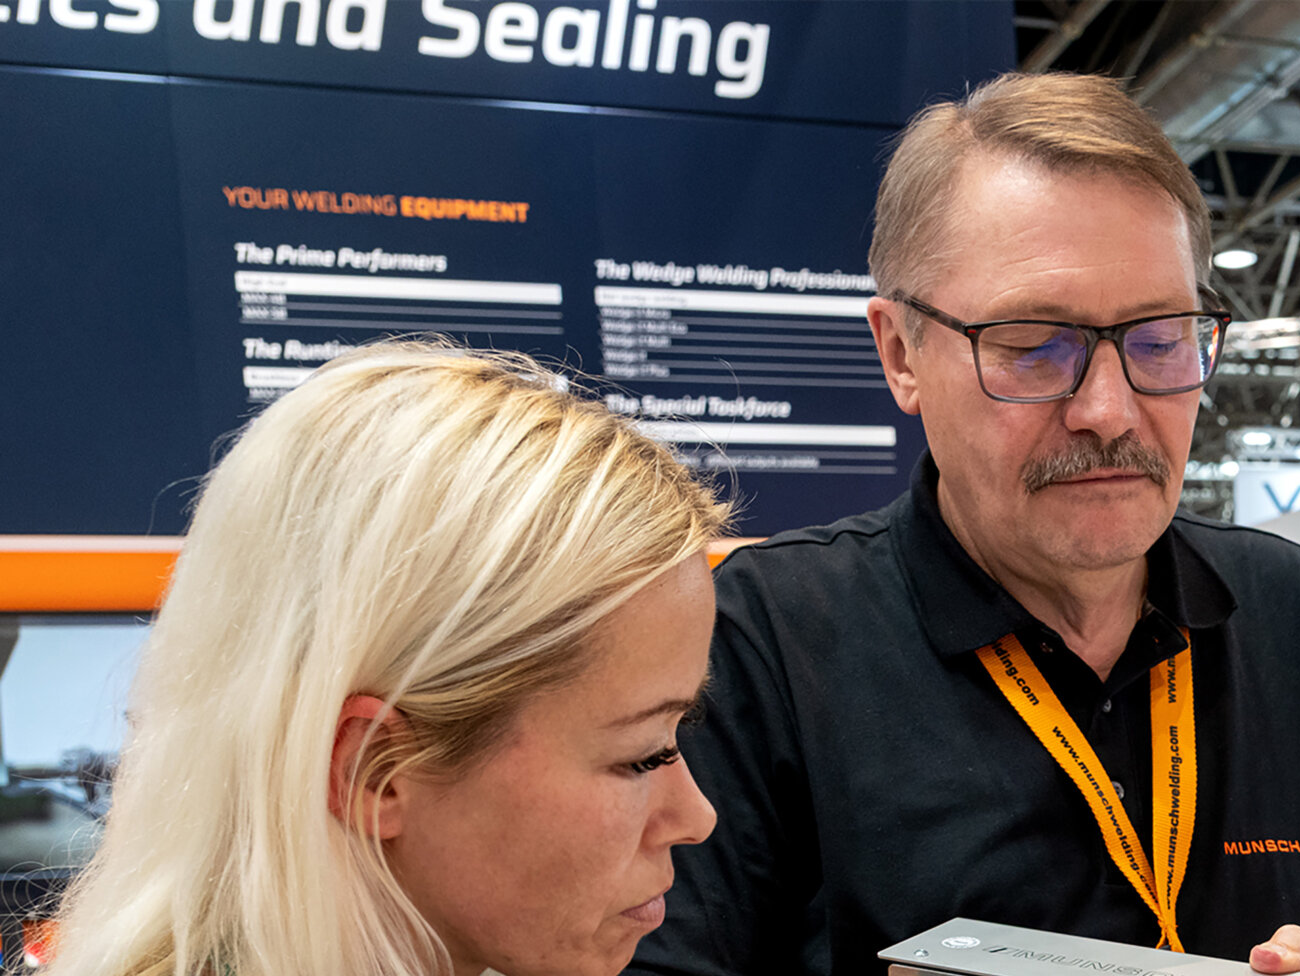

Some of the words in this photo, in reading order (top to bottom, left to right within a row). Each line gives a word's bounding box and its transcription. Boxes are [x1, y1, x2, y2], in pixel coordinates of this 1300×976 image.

[192, 0, 388, 51] and
[418, 0, 771, 99] Sealing
[222, 186, 289, 211] YOUR
[292, 190, 397, 217] WELDING
[400, 195, 530, 223] EQUIPMENT
[234, 242, 274, 265] The
[276, 244, 336, 267] Prime
[337, 247, 448, 273] Performers
[595, 259, 630, 281] The
[632, 261, 695, 286] Wedge
[697, 264, 768, 290] Welding
[243, 338, 282, 360] The
[606, 394, 640, 415] The
[642, 395, 706, 418] Special
[708, 396, 792, 420] Taskforce
[1052, 726, 1159, 905] www.munschwelding.com
[1166, 725, 1182, 910] www.munschwelding.com
